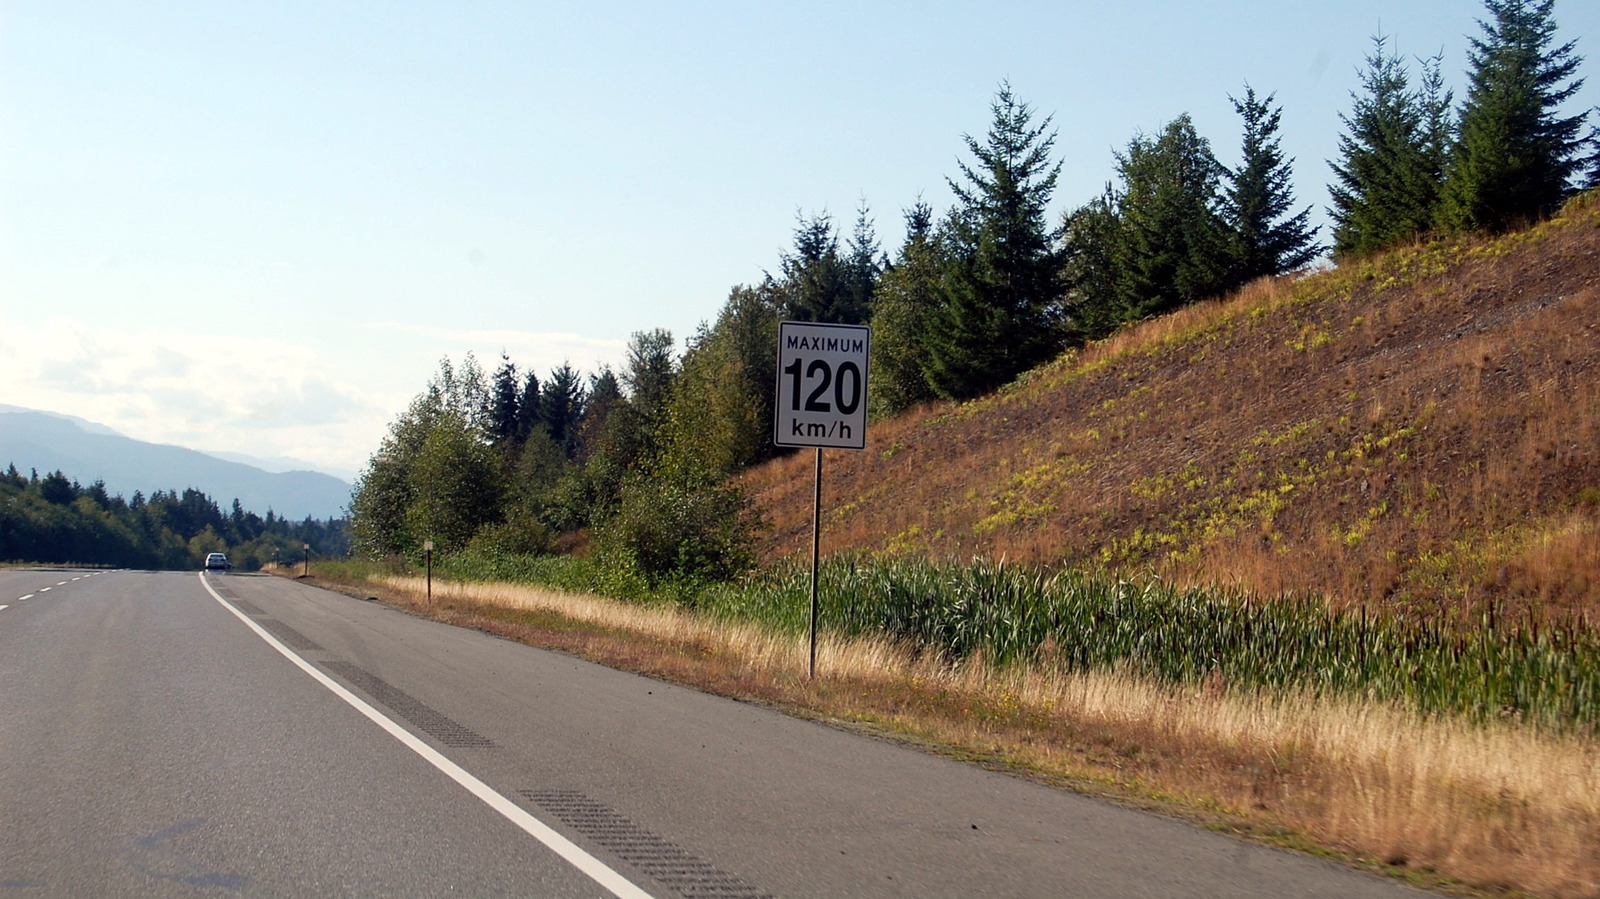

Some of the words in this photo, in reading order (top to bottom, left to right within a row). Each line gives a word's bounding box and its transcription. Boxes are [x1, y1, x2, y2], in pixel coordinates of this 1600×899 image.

[787, 335, 863, 353] MAXIMUM
[785, 358, 861, 415] 120
[792, 418, 851, 439] km/h
